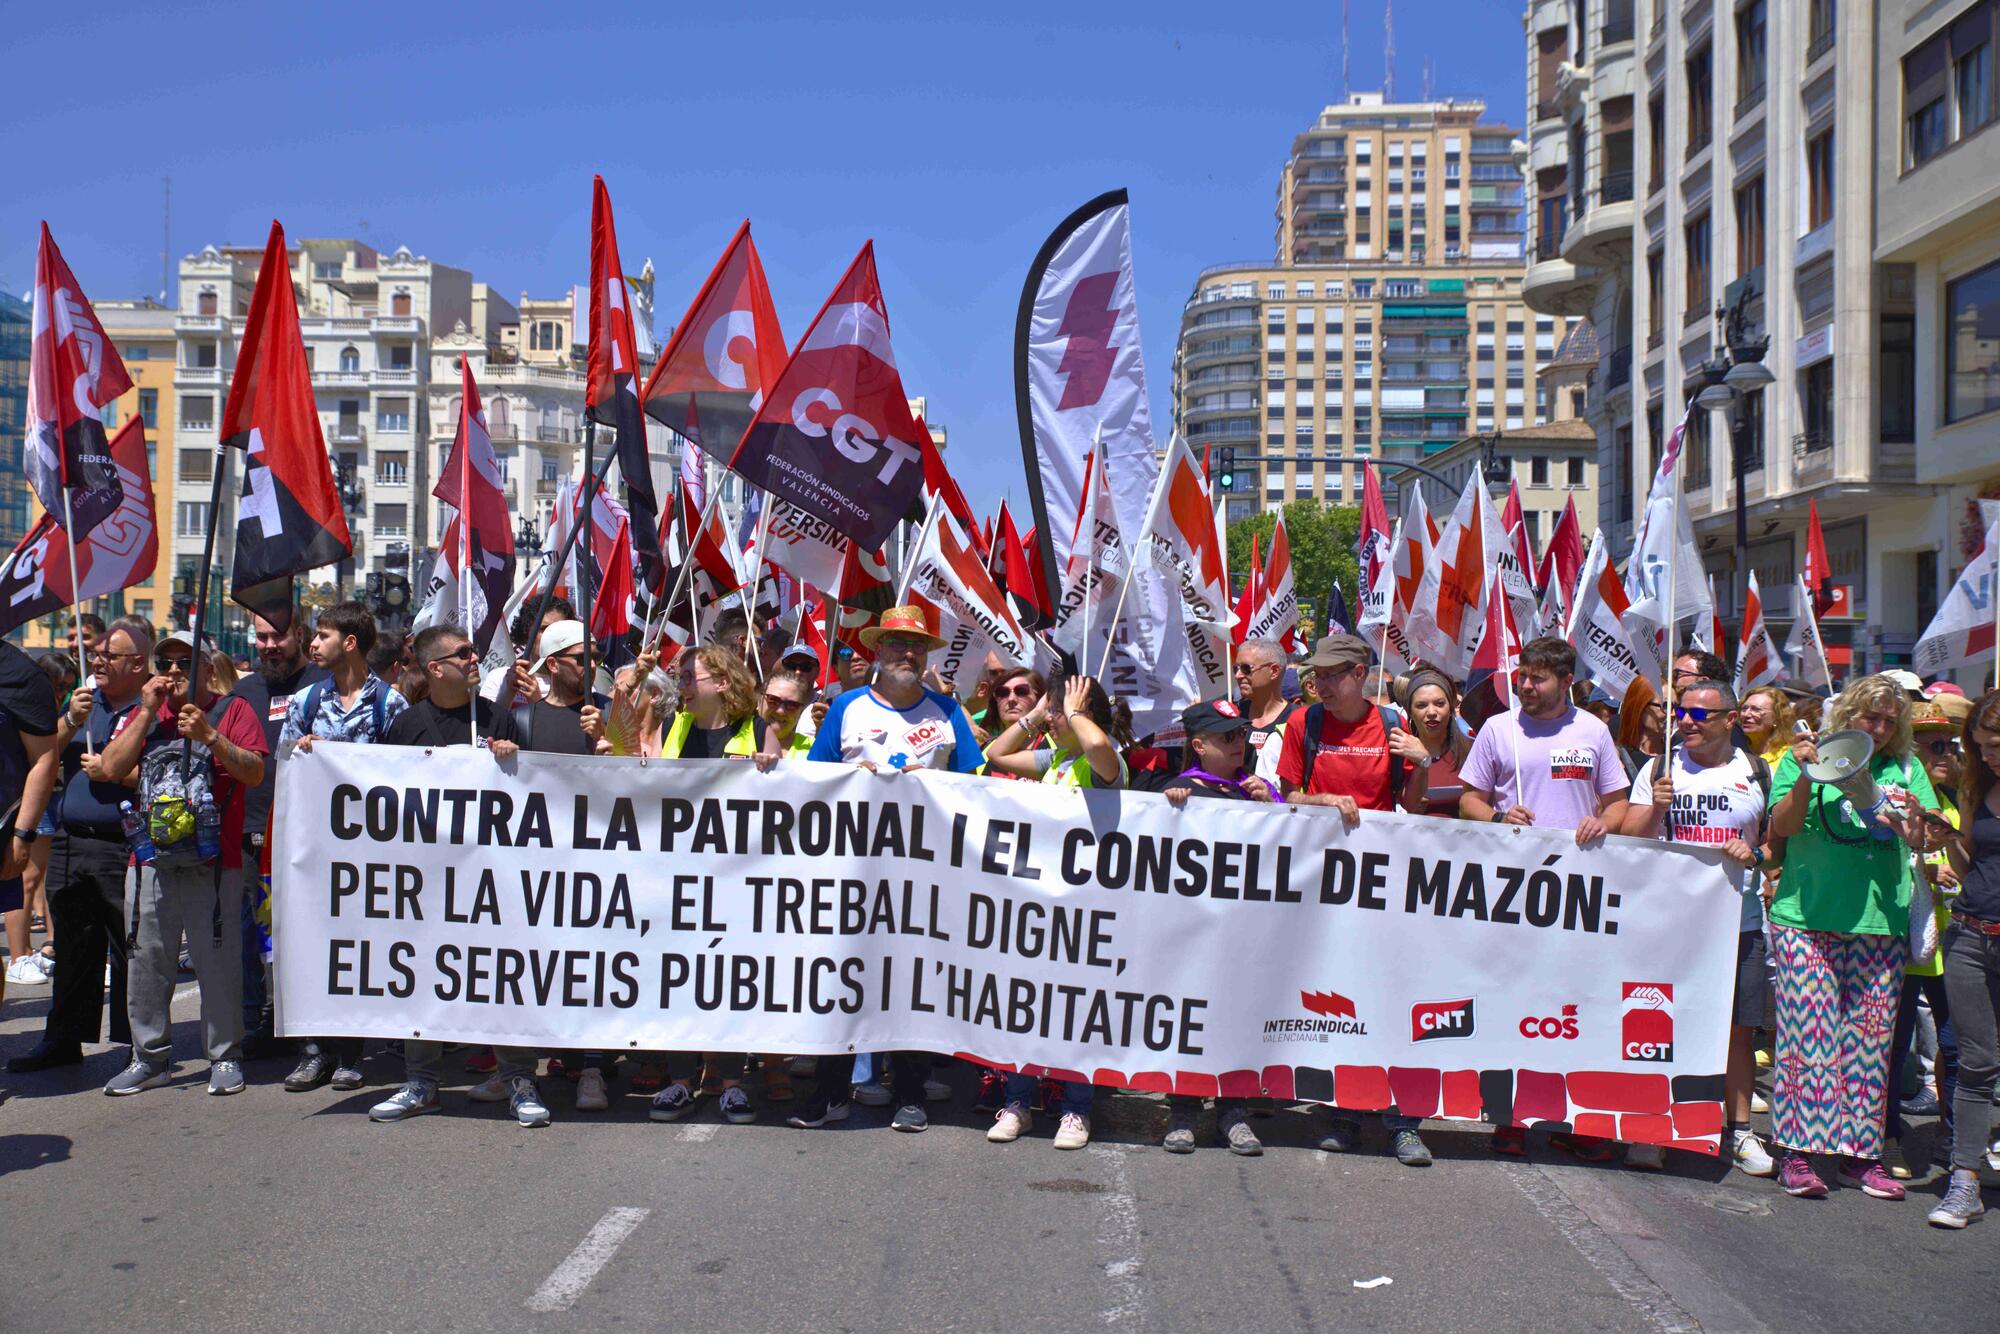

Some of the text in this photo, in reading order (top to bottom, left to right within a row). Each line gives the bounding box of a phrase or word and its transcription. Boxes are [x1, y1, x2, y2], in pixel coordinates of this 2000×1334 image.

[792, 387, 921, 486] CGT
[766, 454, 870, 521] FEDERACIÓN SINDICATOS
[1551, 755, 1592, 764] TANCAT
[1672, 794, 1692, 810] NO
[1672, 810, 1708, 826] TINC
[331, 784, 1622, 934] CONTRA LA PATRONAL I EL CONSELL DE MAZÓN:
[331, 862, 1127, 976] PER LA VIDA, EL TREBALL DIGNE,
[329, 938, 1208, 1055] ELS SERVEIS PÚBLICS I L'HABITATGE
[1263, 1018, 1368, 1036] INTERSINDICAL
[1420, 1009, 1465, 1031] CNT
[1519, 1014, 1579, 1040] COS
[1262, 1032, 1318, 1043] VALENCIANA
[1626, 1042, 1670, 1060] CGT
